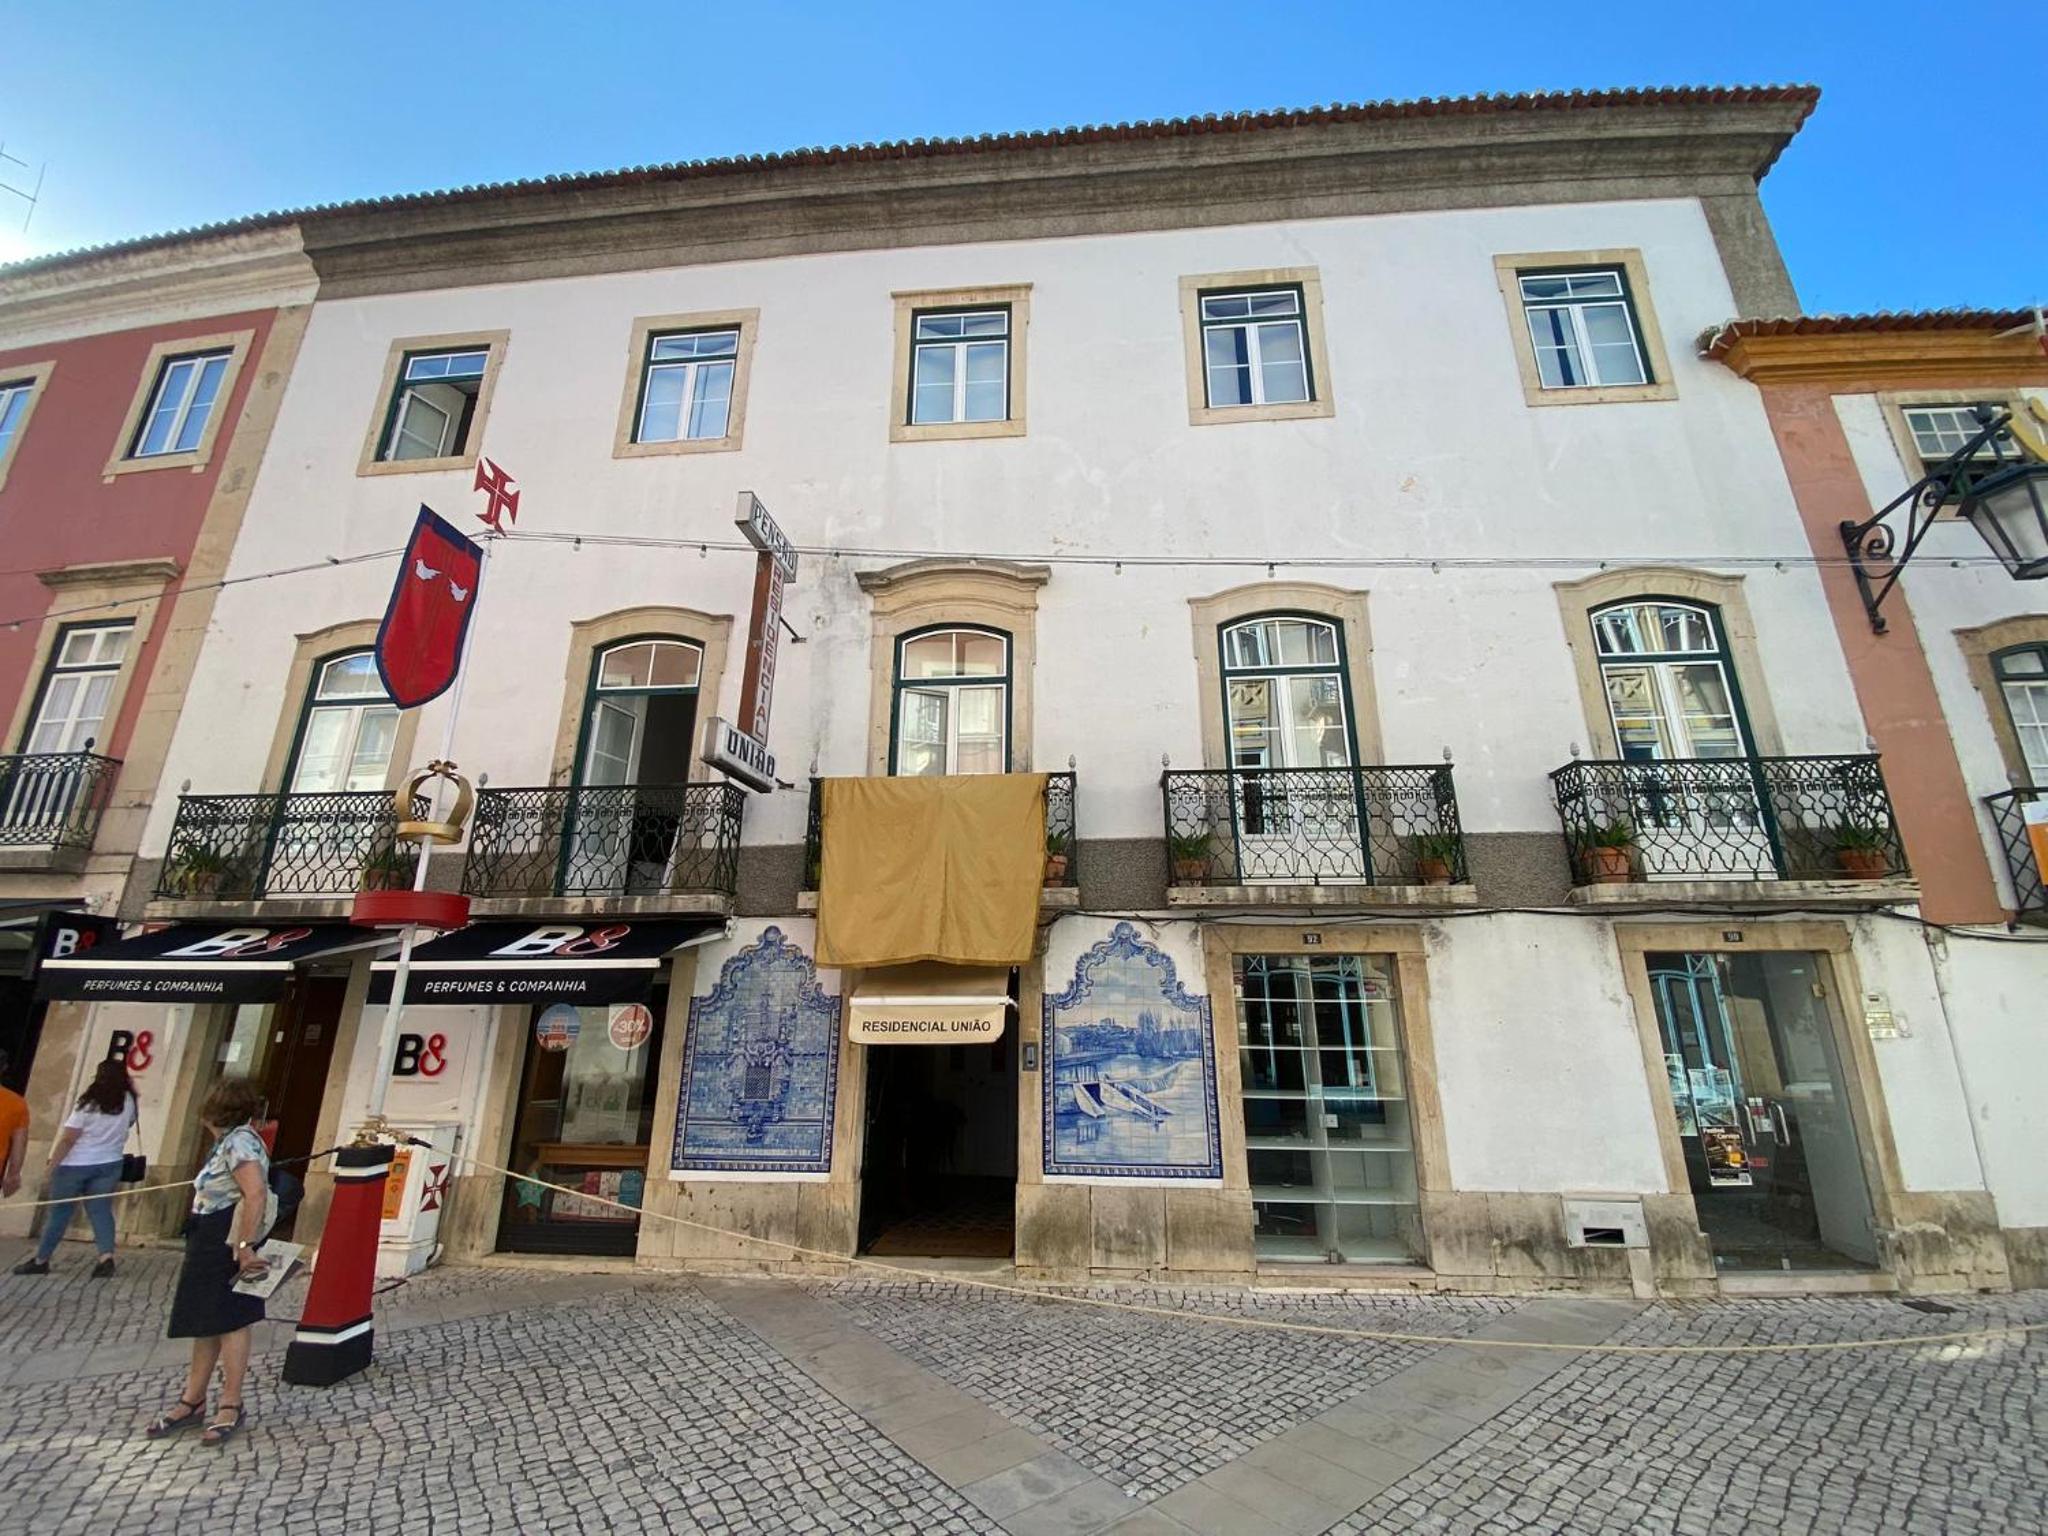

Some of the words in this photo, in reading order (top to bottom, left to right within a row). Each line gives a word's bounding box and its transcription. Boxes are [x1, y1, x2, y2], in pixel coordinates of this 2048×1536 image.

[752, 564, 782, 738] RESIDENCIAL
[161, 927, 313, 957] B&
[488, 925, 631, 955] B&
[83, 979, 140, 992] PERFUMES
[142, 980, 151, 991] &
[154, 979, 224, 993] COMPANHIA
[424, 980, 493, 993] PERFUMES
[497, 980, 505, 992] &
[509, 979, 587, 993] COMPANHIA
[862, 1020, 947, 1033] RESIDENCIAL
[951, 1018, 992, 1033] UNIÃO
[393, 1033, 446, 1076] B&
